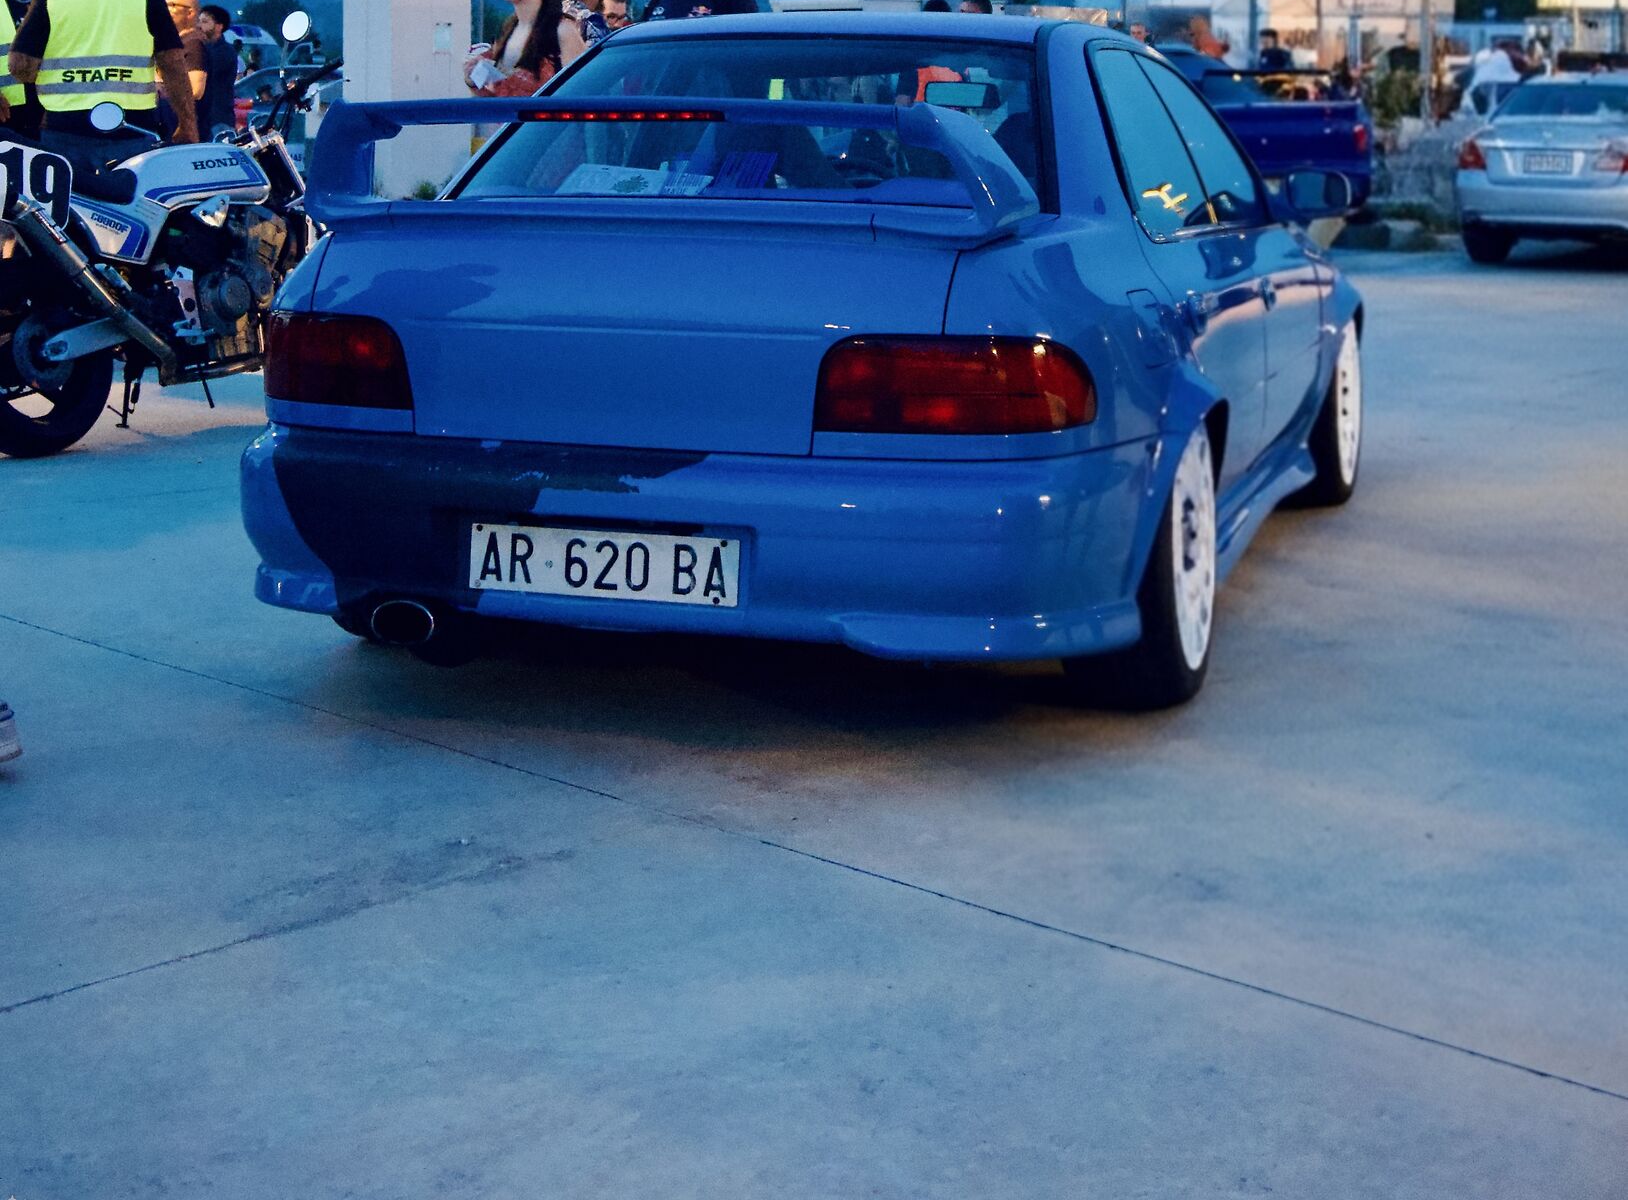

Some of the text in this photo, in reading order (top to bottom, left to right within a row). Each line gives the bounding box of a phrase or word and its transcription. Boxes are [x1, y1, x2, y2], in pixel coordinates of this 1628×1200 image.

[62, 68, 133, 83] STAFF
[191, 156, 250, 171] HONDA
[0, 146, 71, 230] 19
[479, 531, 726, 599] AR 620 BA
